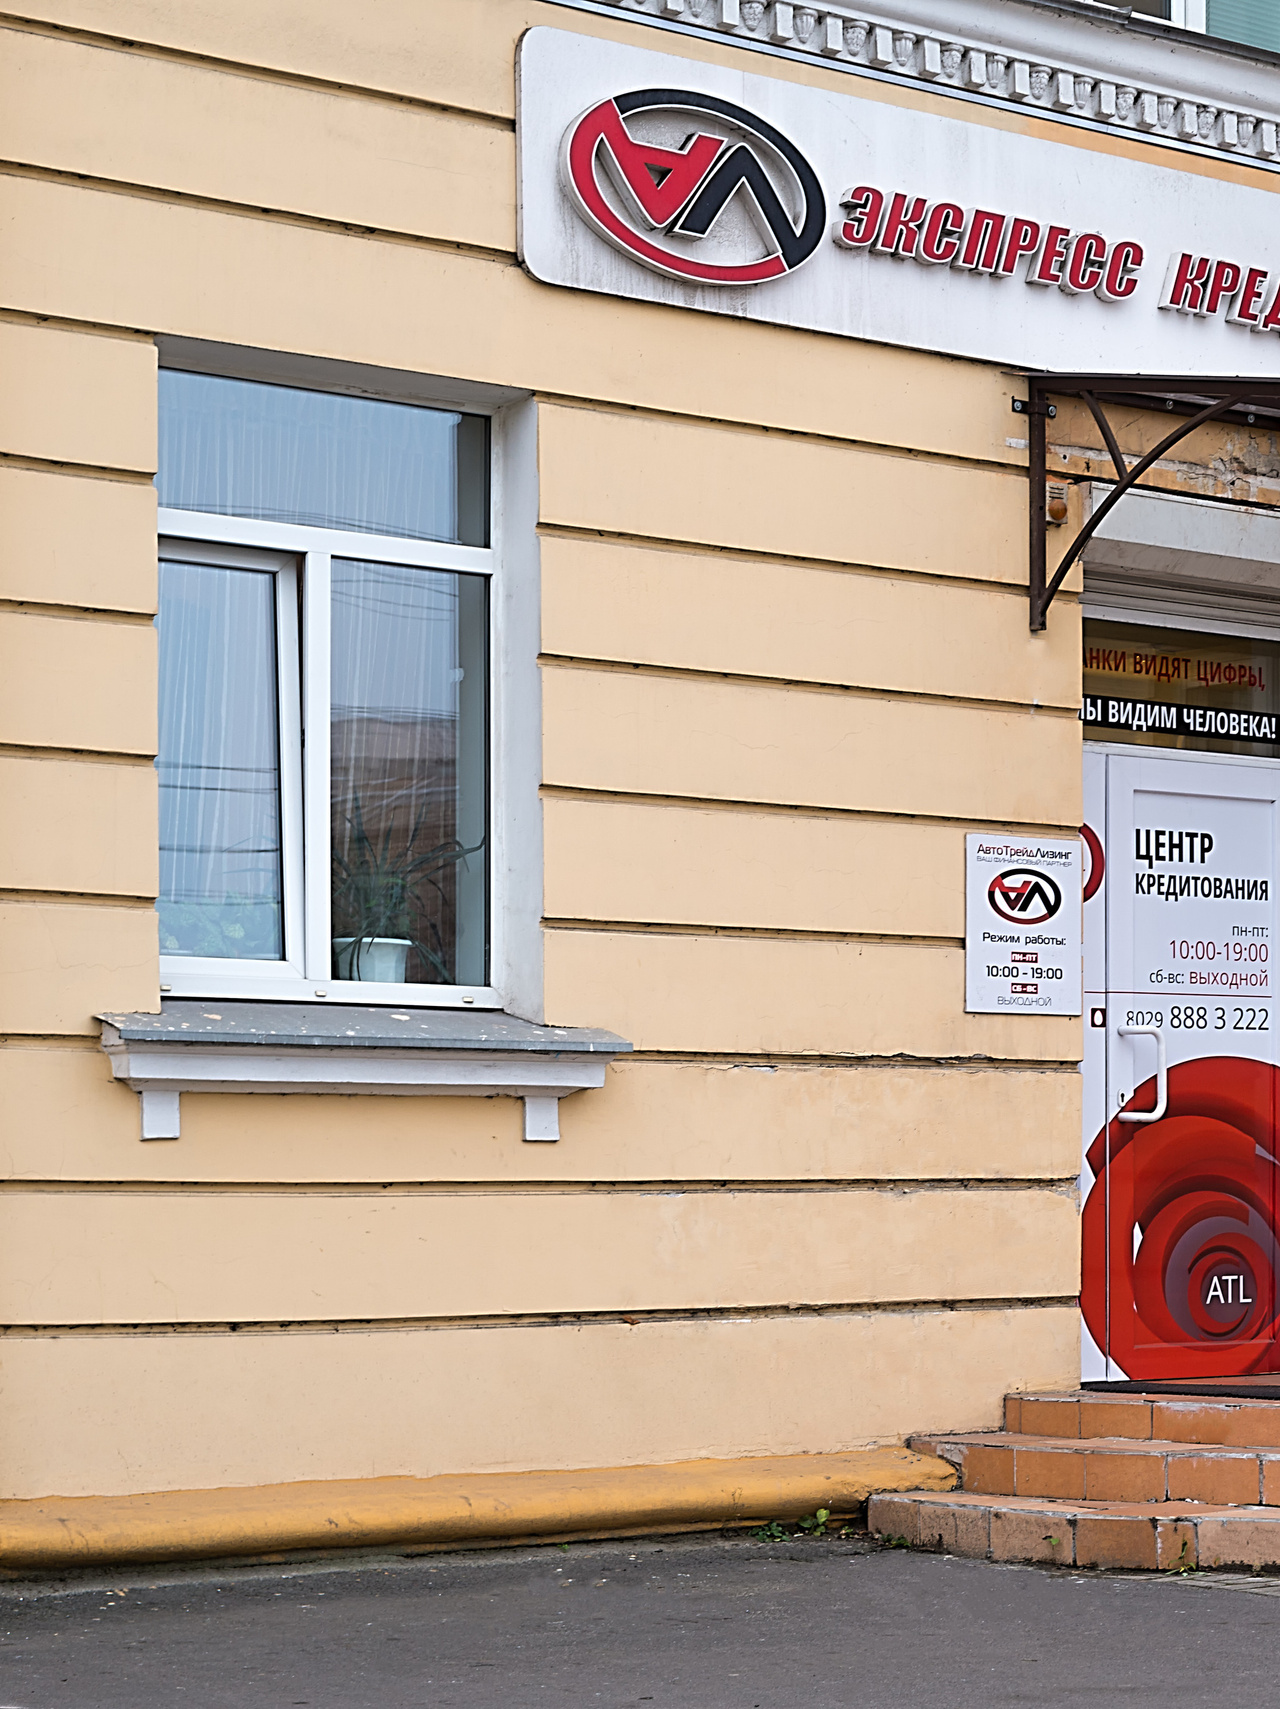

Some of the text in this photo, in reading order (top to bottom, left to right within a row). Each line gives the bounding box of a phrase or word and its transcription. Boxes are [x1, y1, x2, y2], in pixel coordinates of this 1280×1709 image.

[838, 185, 1144, 300] ЭКСПРЕСС
[1133, 652, 1191, 683] ВИДЯТ
[1197, 660, 1266, 691] ЦИФРЫ,
[1108, 700, 1177, 731] ВИДИМ
[1183, 708, 1276, 739] ЧЕЛОВЕКА!
[977, 843, 1072, 860] АвтоТрейдЛизинг
[1135, 828, 1214, 869] ЦЕНТР
[1135, 872, 1269, 902] КРЕДИТОВАНИЯ
[982, 931, 1067, 946] Режим работы:
[1232, 925, 1269, 938] пн-пт:
[1169, 940, 1269, 962] 10:00-19:00
[986, 965, 1020, 978] 10:00
[1030, 967, 1063, 980] 19:00
[1149, 969, 1269, 989] сб-вс: ВЫХОДНОЙ
[997, 996, 1052, 1006] ВЫХОДНОЙ
[1126, 1006, 1270, 1031] 8029 888 3 222
[1205, 1275, 1252, 1305] ATL
